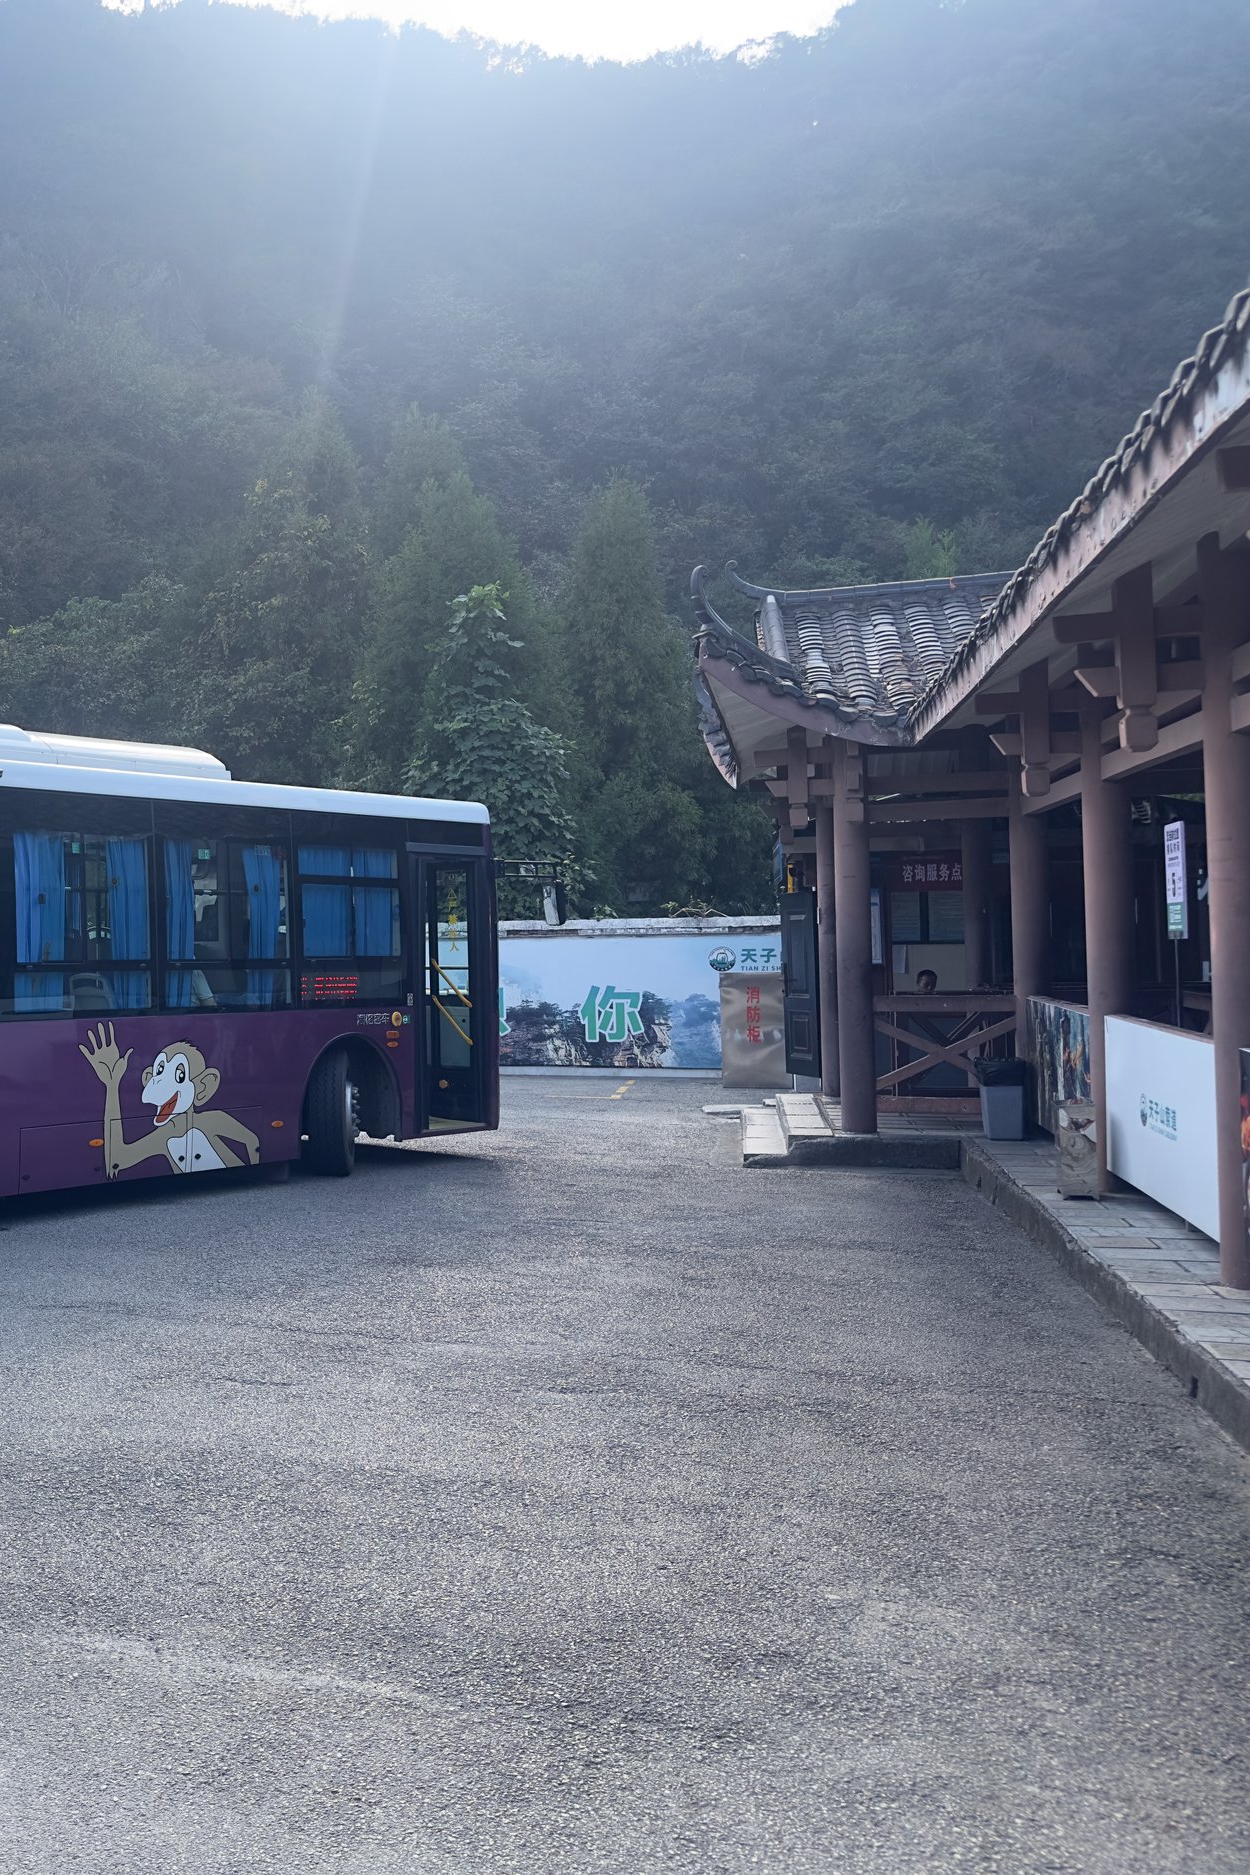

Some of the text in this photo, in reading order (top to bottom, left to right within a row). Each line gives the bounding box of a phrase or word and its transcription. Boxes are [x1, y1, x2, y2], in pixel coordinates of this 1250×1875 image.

[902, 863, 962, 882] 咨询服务点
[741, 948, 782, 963] 天子
[579, 985, 645, 1042] 你
[747, 986, 761, 1042] 消防柜
